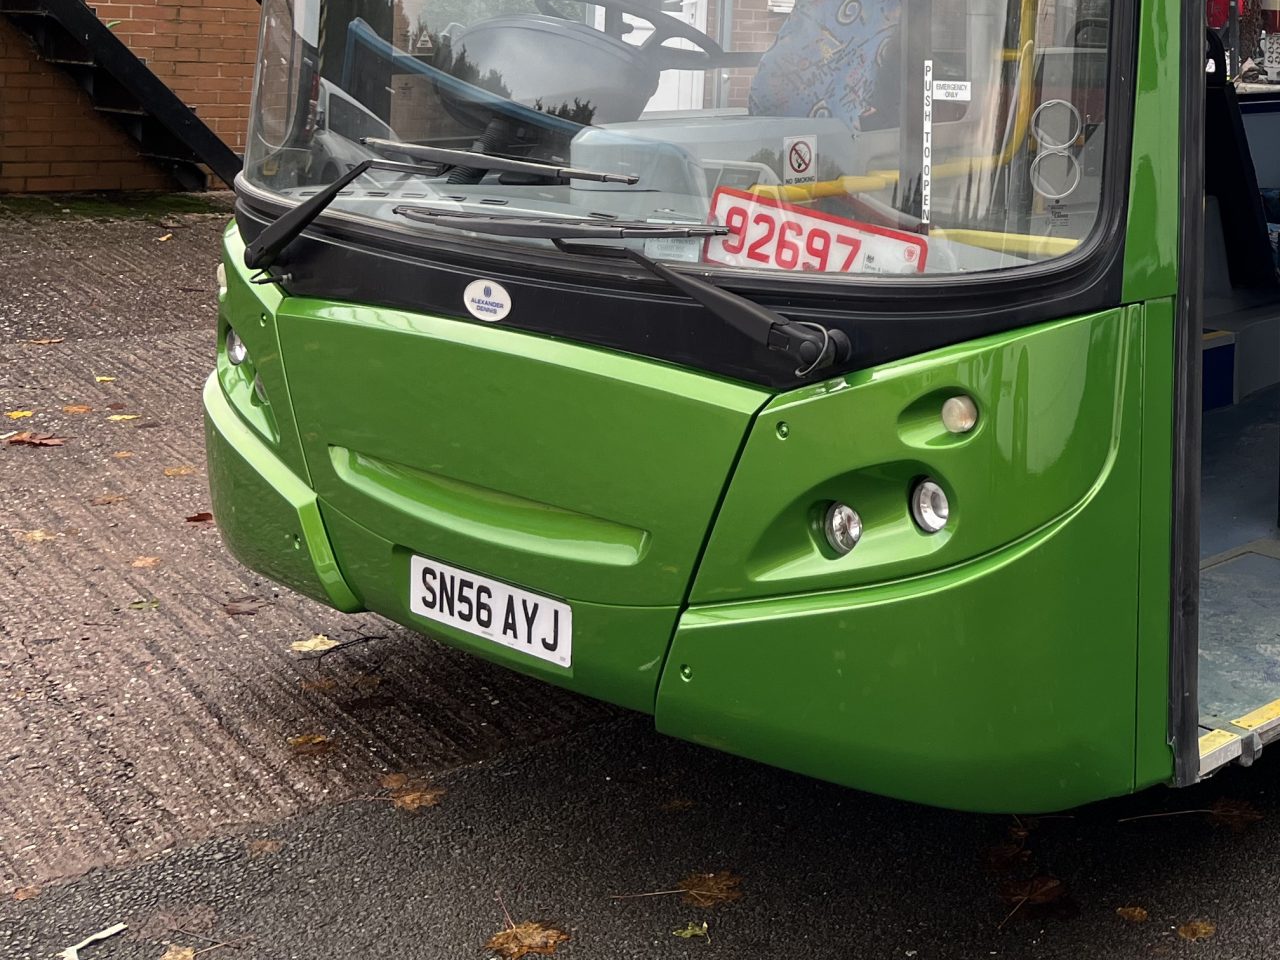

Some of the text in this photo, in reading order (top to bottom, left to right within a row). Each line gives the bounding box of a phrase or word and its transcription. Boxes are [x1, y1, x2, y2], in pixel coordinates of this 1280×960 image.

[936, 83, 967, 91] EMERGENCY
[922, 65, 932, 221] PUSH TO OPEN
[794, 175, 815, 184] SMOKING
[721, 206, 861, 272] 92697
[471, 297, 504, 309] ALEXANDER
[476, 305, 498, 315] DENNIS
[421, 566, 559, 652] SN56 AYJ
